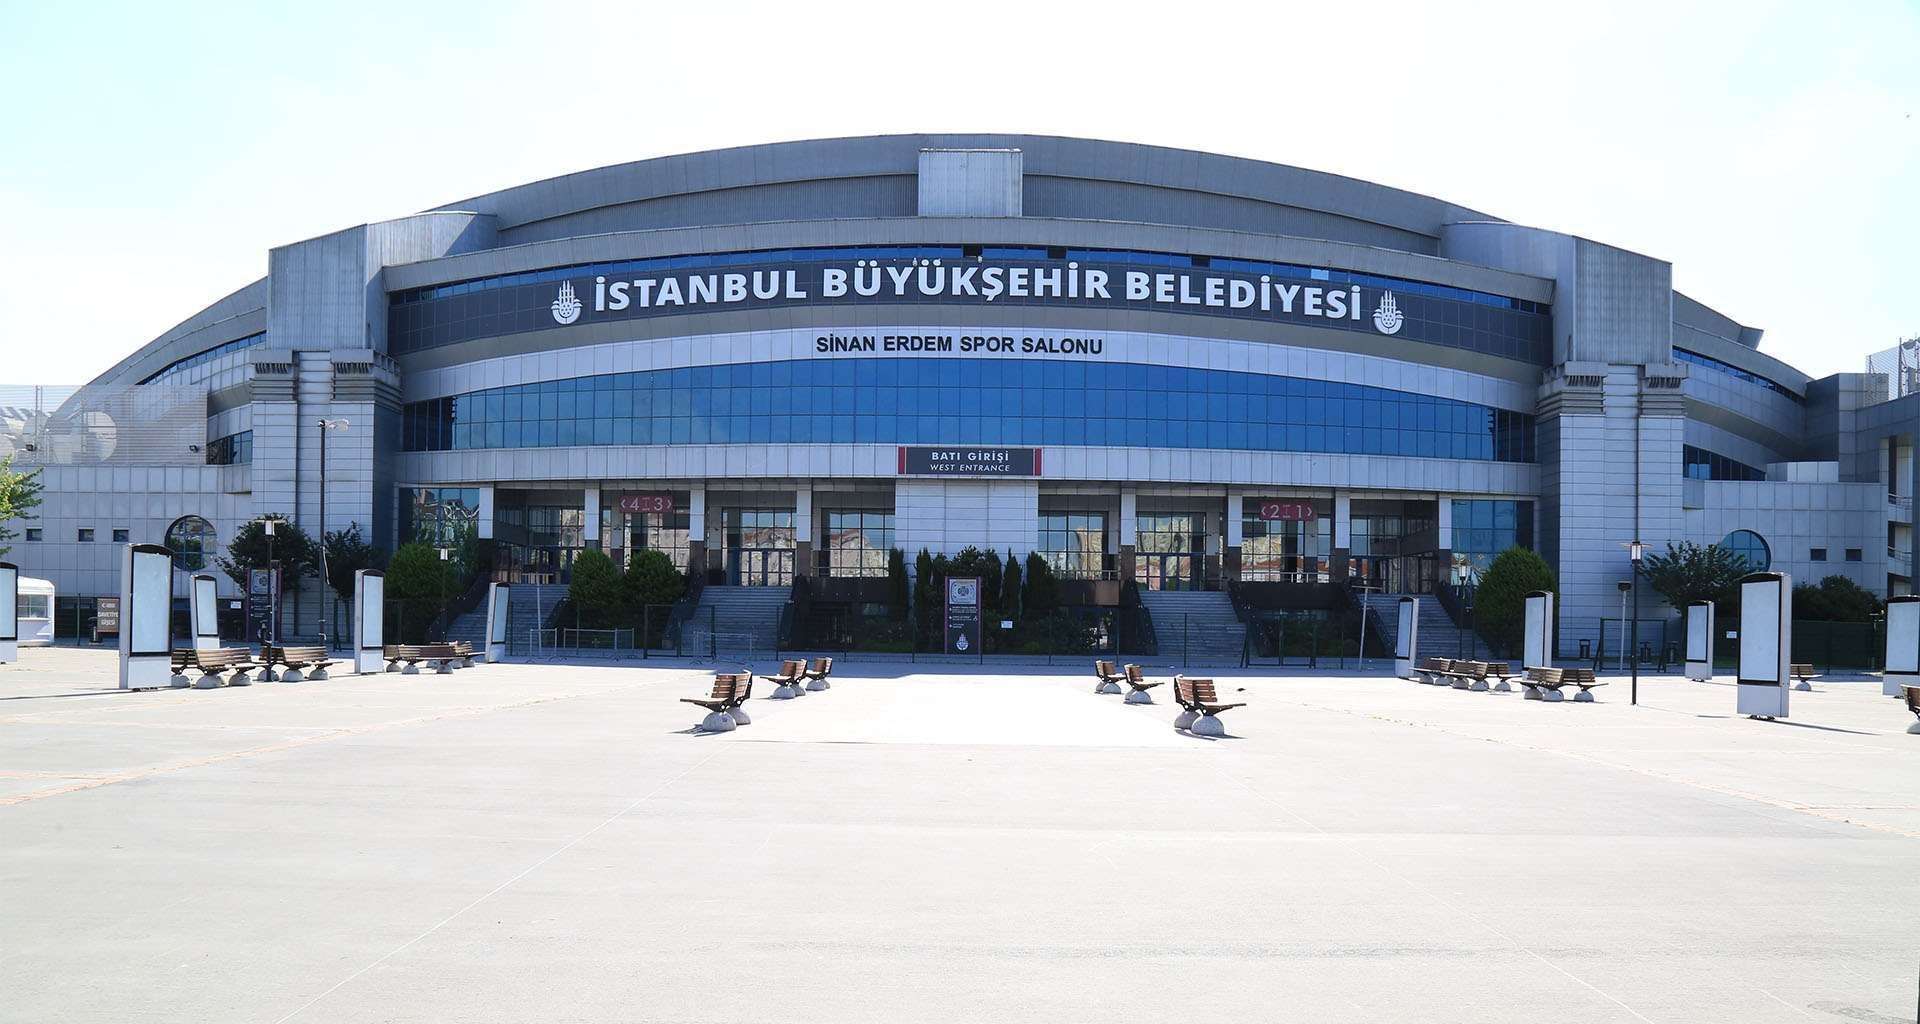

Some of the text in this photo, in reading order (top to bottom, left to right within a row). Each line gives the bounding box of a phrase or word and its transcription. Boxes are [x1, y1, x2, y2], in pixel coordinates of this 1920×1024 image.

[595, 260, 1361, 321] İSTANBUL BÜYÜKŞEHİR BELEDİYESİ
[817, 334, 1103, 355] SİNAN ERDEM SPOR SALONU
[931, 450, 1009, 463] BATI GİRİŞİ
[930, 463, 1010, 472] WEST ENTRANCE
[630, 497, 663, 511] 4 3
[1270, 504, 1302, 518] 2 1
